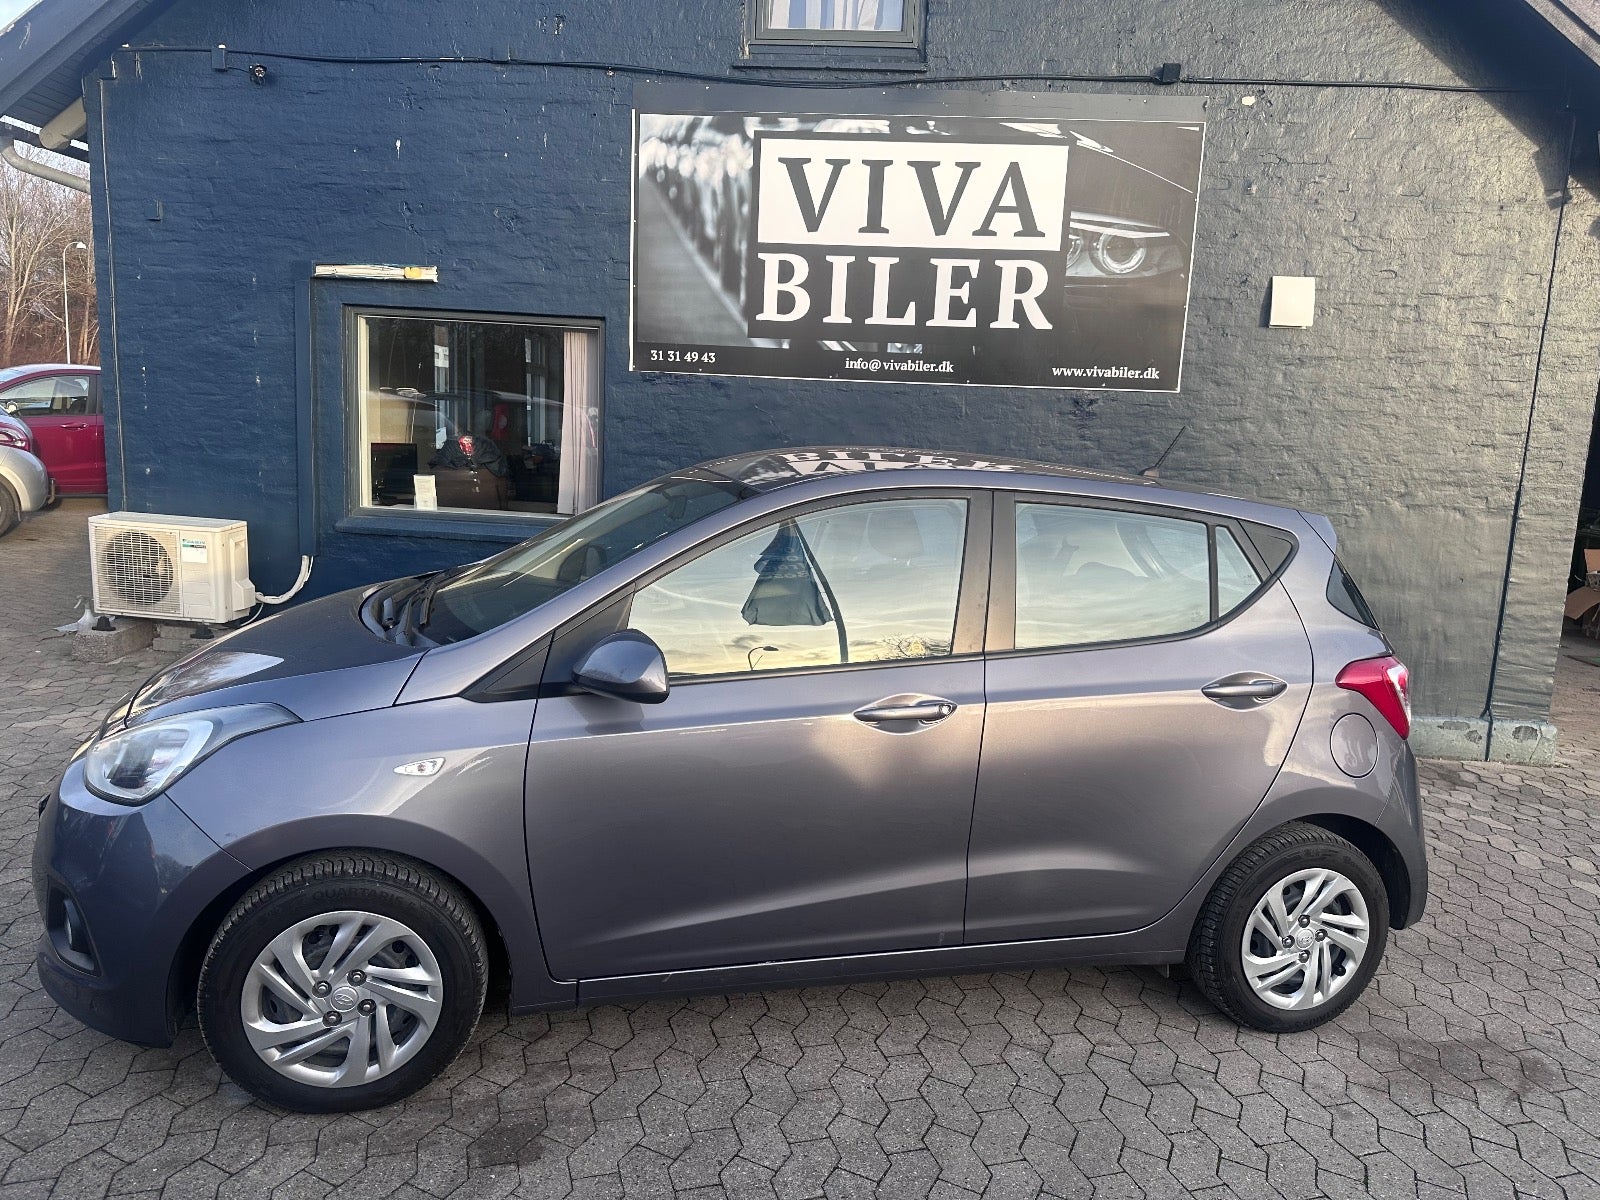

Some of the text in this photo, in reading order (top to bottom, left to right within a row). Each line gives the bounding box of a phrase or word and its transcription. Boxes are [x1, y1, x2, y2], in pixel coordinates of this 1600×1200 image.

[777, 157, 1046, 238] VIVA
[755, 252, 1053, 330] BILER
[650, 349, 716, 363] 31 31 49 43
[1051, 365, 1160, 380] www.vivabiler.dk
